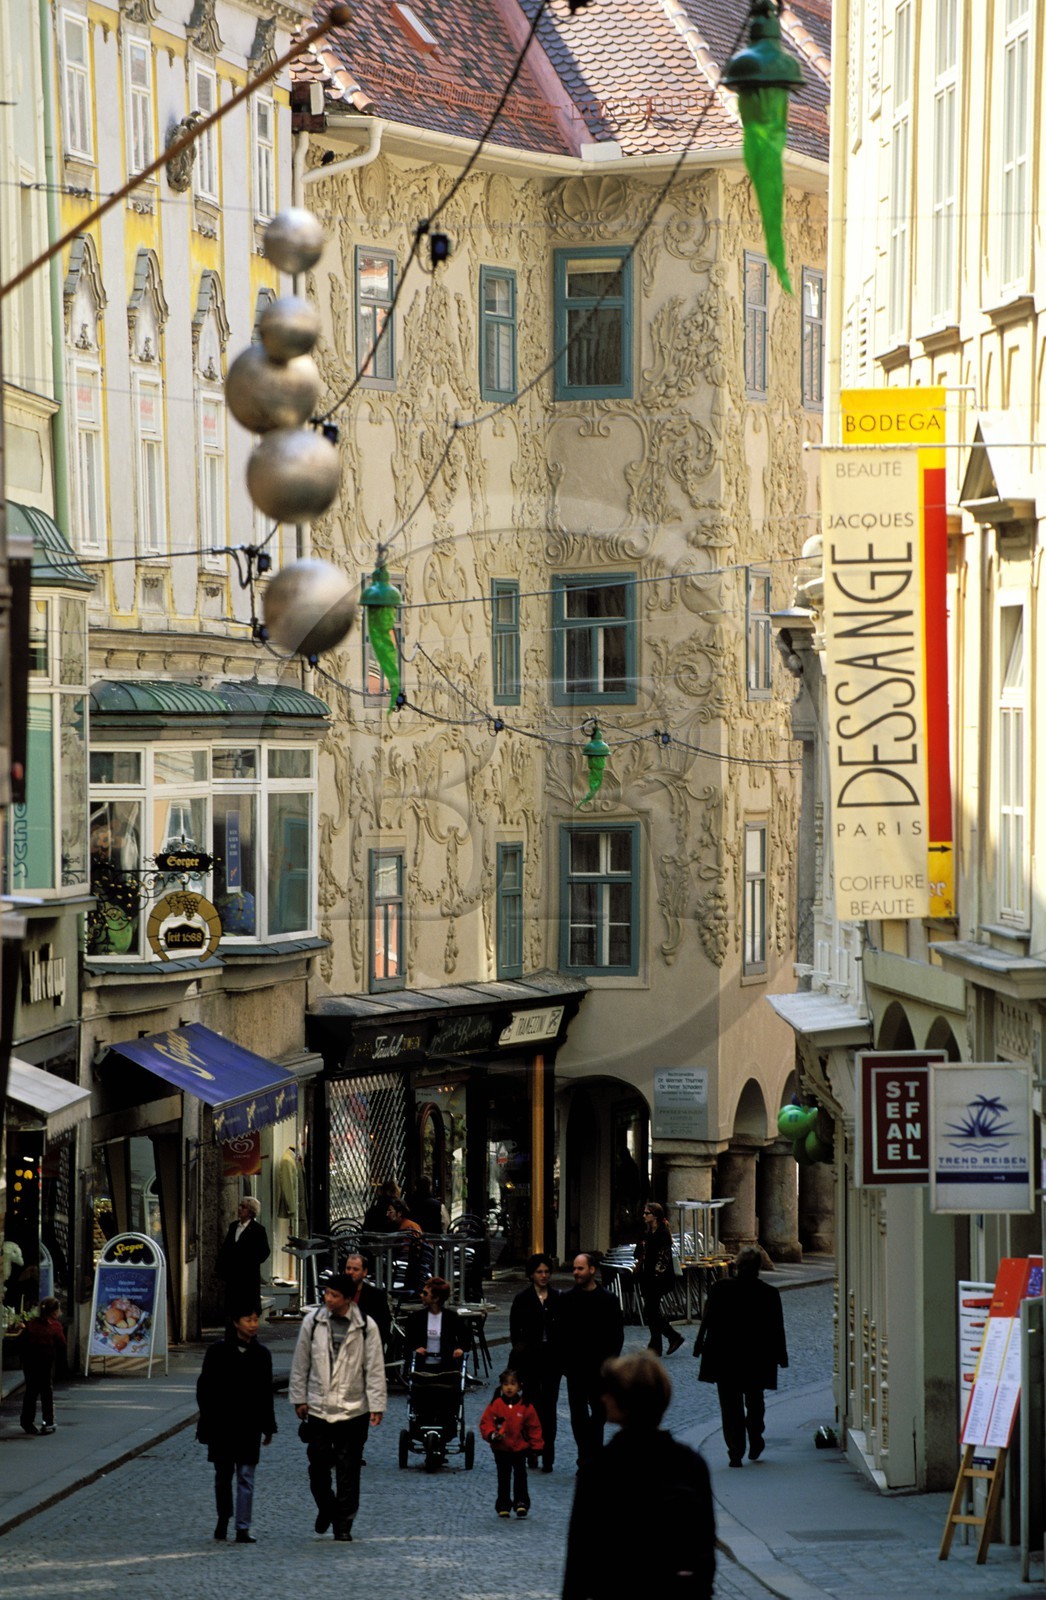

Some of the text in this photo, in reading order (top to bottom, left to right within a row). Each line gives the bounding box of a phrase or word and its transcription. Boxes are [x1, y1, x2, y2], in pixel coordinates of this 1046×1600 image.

[846, 413, 941, 432] BODEGA
[827, 513, 914, 531] JACQUES
[831, 542, 920, 807] DESSANGE
[837, 821, 922, 837] PARIS
[839, 874, 924, 892] COIFFURE
[886, 1081, 920, 1098] ST
[886, 1102, 920, 1118] EF
[886, 1123, 921, 1139] AN
[887, 1144, 921, 1160] EL
